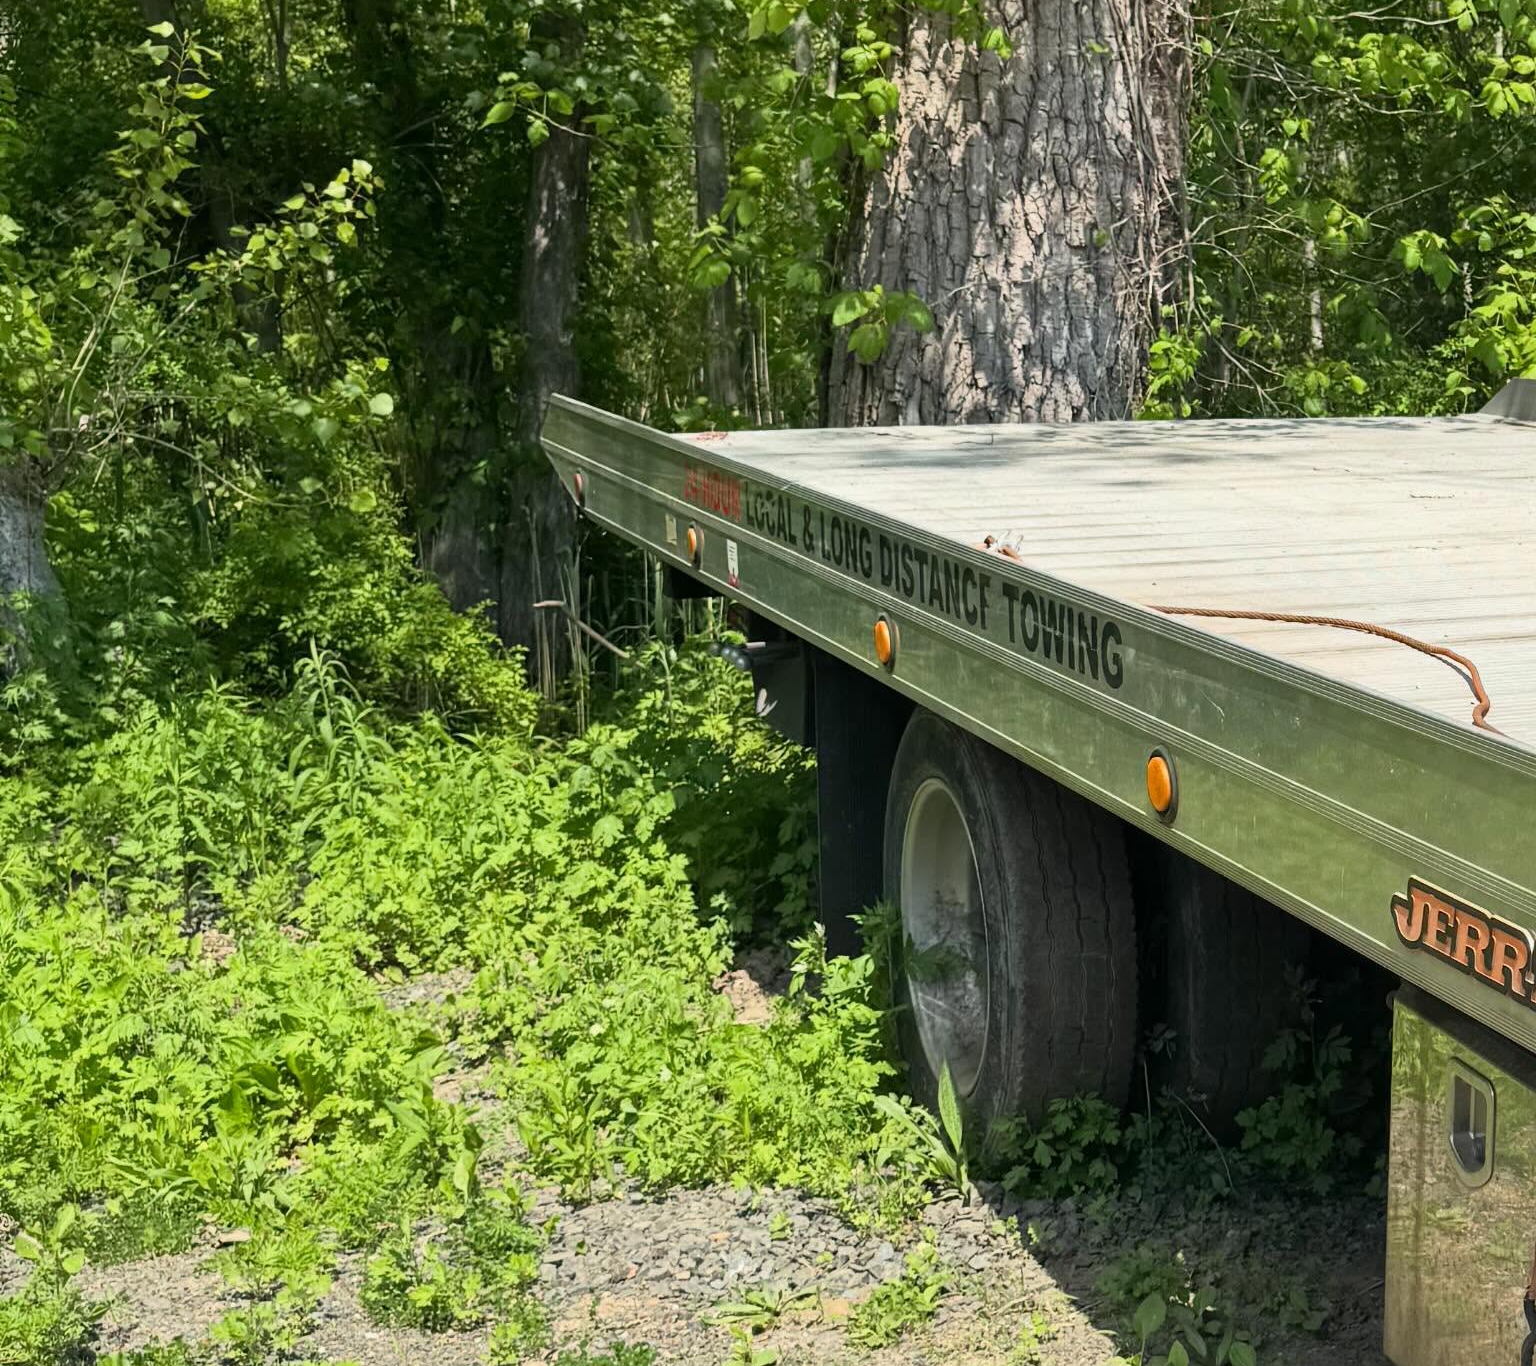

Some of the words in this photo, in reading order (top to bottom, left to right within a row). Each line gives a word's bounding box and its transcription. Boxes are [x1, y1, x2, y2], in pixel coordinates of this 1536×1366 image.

[745, 481, 797, 546] LOCAL
[803, 504, 815, 552] &
[820, 511, 873, 579] LONG
[1003, 582, 1124, 689] TOWING
